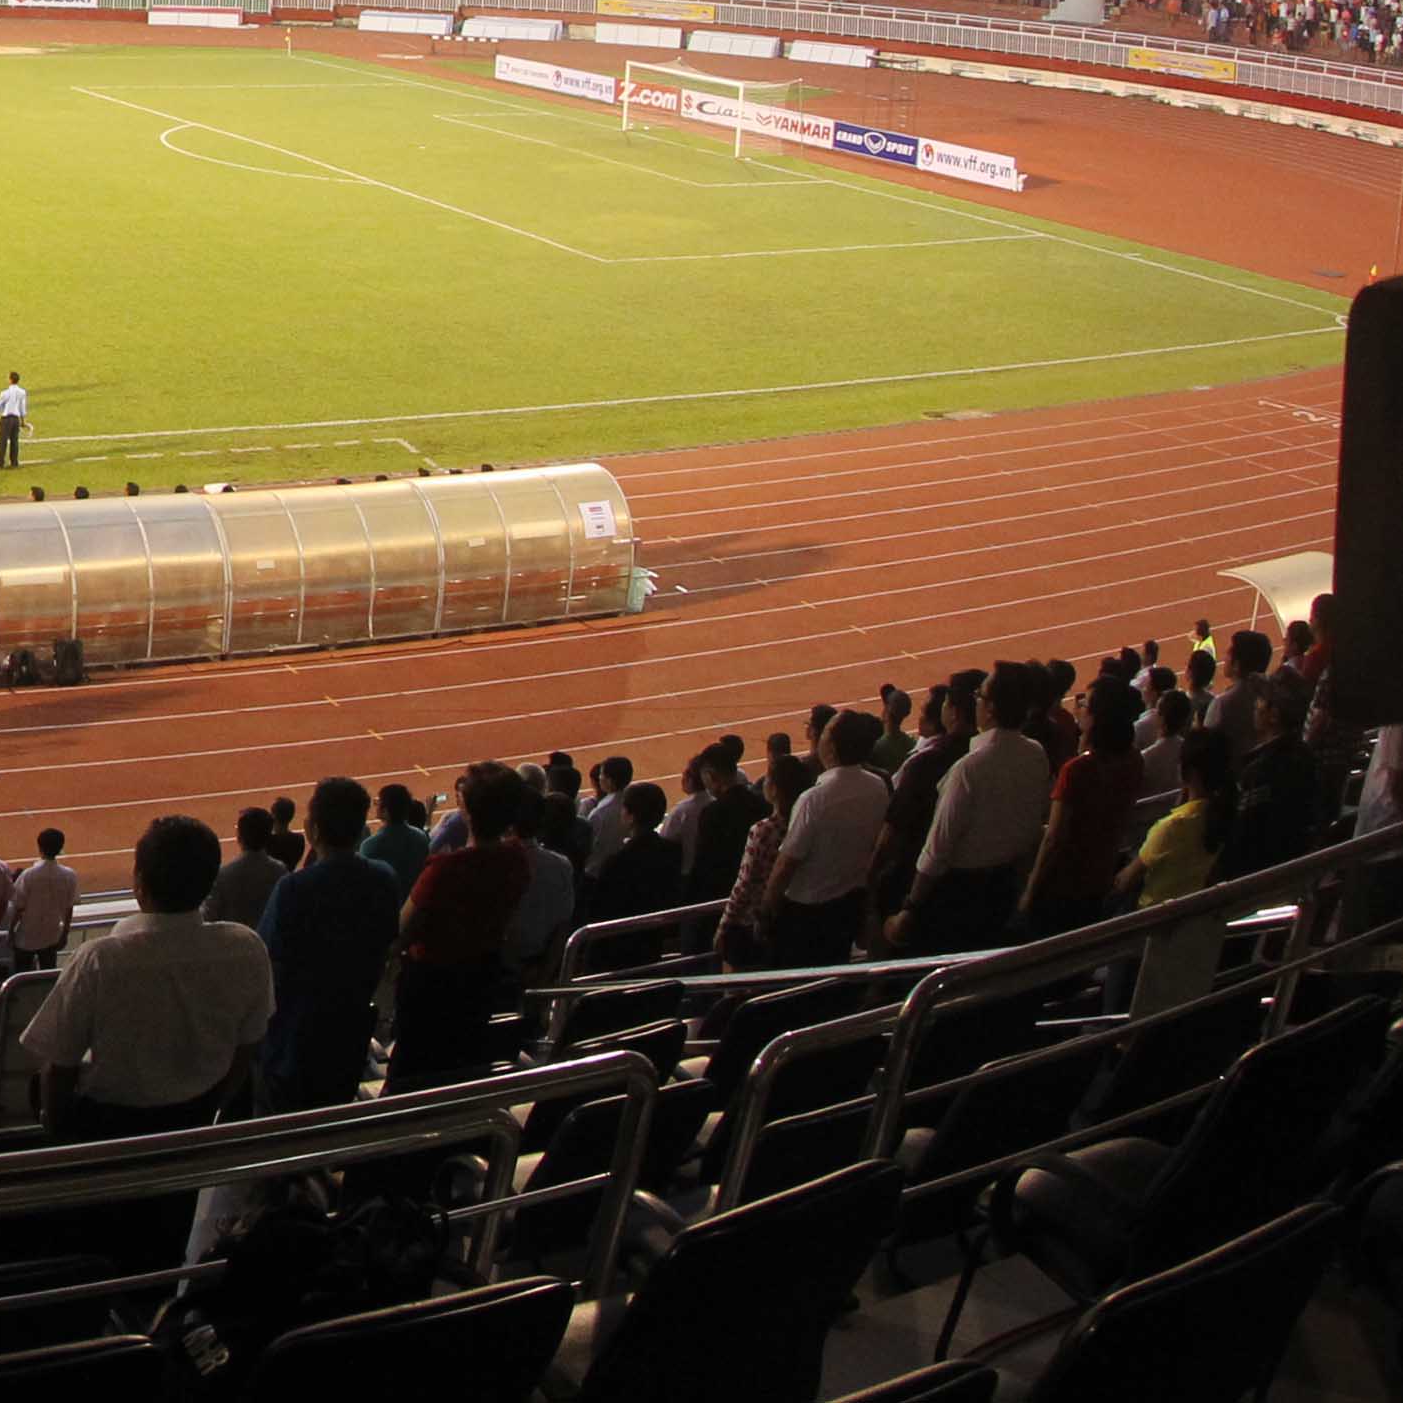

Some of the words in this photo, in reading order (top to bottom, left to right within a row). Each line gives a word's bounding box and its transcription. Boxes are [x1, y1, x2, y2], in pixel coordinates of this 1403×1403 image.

[618, 80, 678, 111] Z.com
[773, 115, 831, 141] YANMAR
[836, 130, 863, 145] GRAND
[885, 141, 914, 157] SPORT
[936, 151, 1012, 179] www.vff.org.vn
